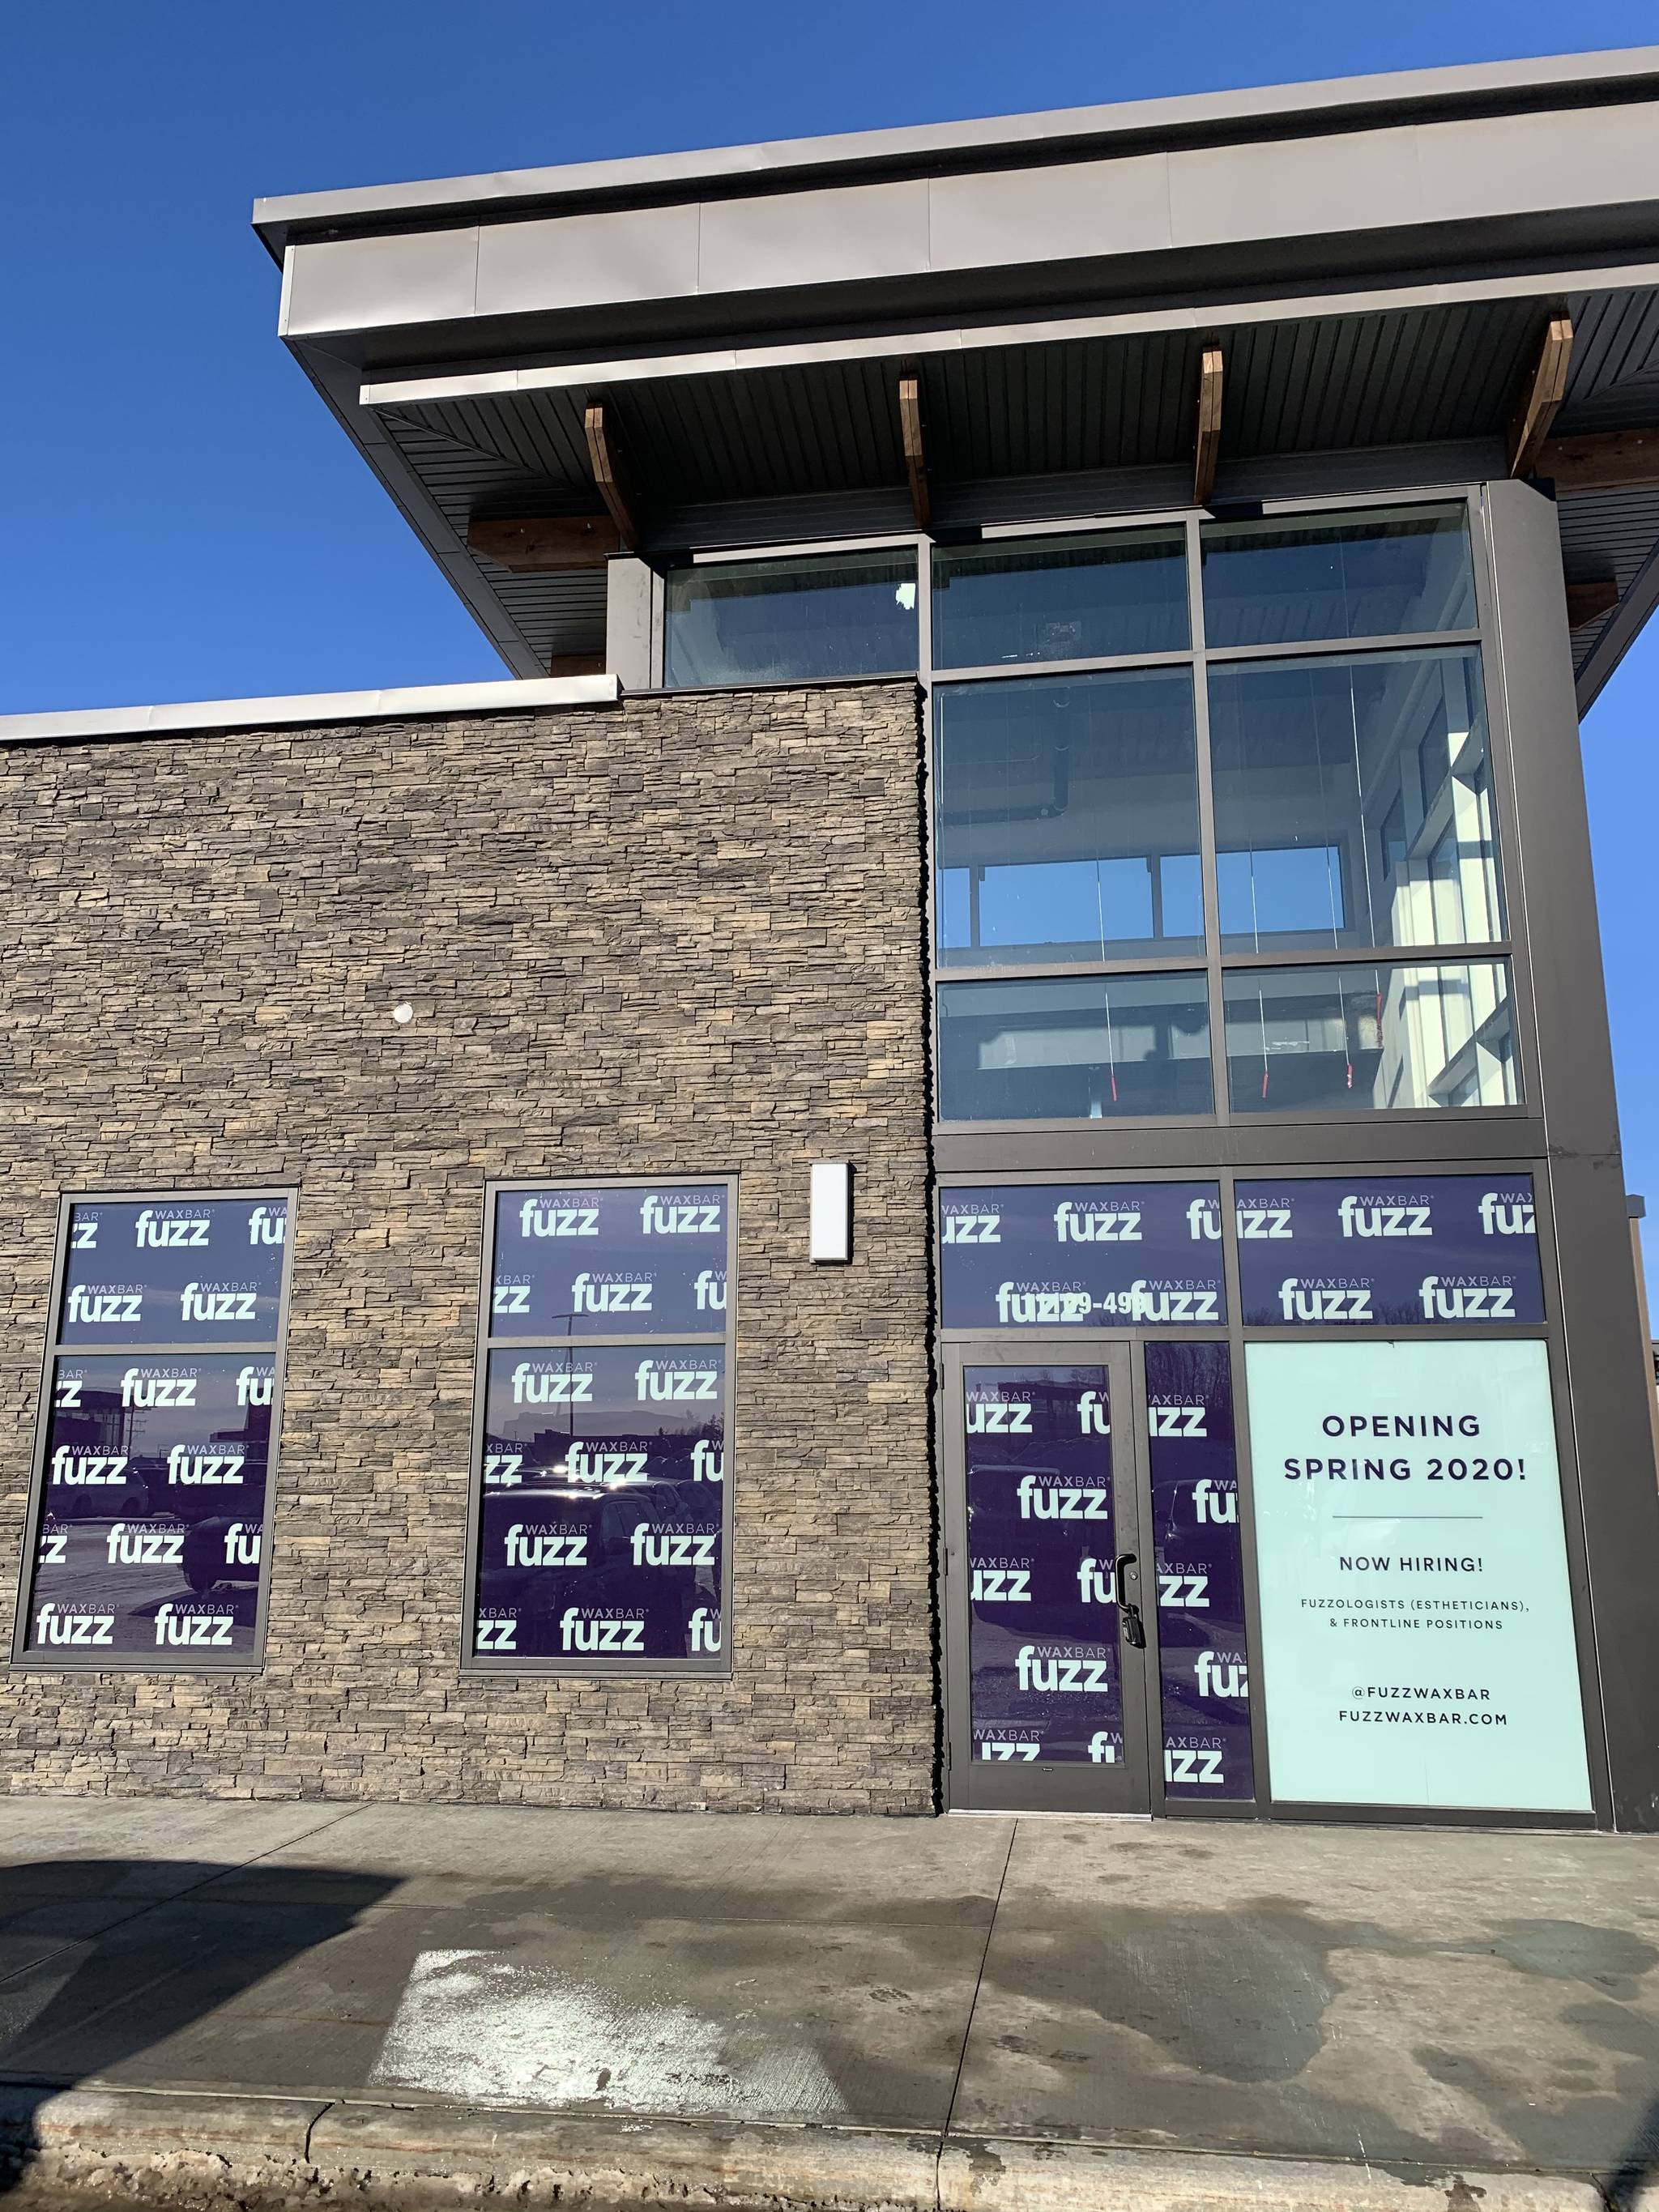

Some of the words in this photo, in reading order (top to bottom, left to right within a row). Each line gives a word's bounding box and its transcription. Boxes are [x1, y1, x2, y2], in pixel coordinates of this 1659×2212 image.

[540, 1198, 599, 1208] WAXBAR
[660, 1195, 720, 1204] WAXBAR
[1075, 1201, 1140, 1212] WAXBAR
[1360, 1195, 1429, 1206] WAXBAR
[155, 1209, 211, 1219] WAXBAR
[520, 1199, 599, 1238] fuzz
[640, 1196, 720, 1234] fuzz
[1054, 1202, 1142, 1242] fuzz
[1337, 1196, 1432, 1238] fuzz
[135, 1210, 210, 1247] fuzz
[249, 1207, 286, 1245] fu
[593, 1272, 652, 1282] WAXBAR
[1149, 1280, 1216, 1290] WAXBAR
[1300, 1278, 1369, 1289] WAXBAR
[1441, 1276, 1512, 1286] WAXBAR
[87, 1285, 143, 1294] WAXBAR
[201, 1282, 257, 1292] WAXBAR
[572, 1272, 652, 1313] fuzz
[1016, 1281, 1081, 1292] WAXBAR
[68, 1285, 143, 1323] fuzz
[181, 1282, 257, 1321] fuzz
[996, 1282, 1084, 1323] fuzz
[1131, 1280, 1219, 1321] fuzz
[1278, 1278, 1373, 1320] fuzz
[1419, 1276, 1516, 1319] fuzz
[532, 1362, 592, 1372] WAXBAR
[655, 1359, 717, 1370] WAXBAR
[141, 1368, 197, 1378] WAXBAR
[635, 1360, 717, 1400] fuzz
[121, 1368, 196, 1407] fuzz
[236, 1366, 275, 1406] fu
[512, 1363, 592, 1403] fuzz
[1149, 1395, 1204, 1405] AXBAR
[1322, 1414, 1480, 1438] OPENING
[72, 1446, 128, 1455] WAXBAR
[187, 1445, 245, 1455] WAXBAR
[586, 1442, 647, 1451] WAXBAR
[52, 1446, 128, 1485] fuzz
[167, 1444, 245, 1485] fuzz
[565, 1441, 648, 1483] fuzz
[1284, 1458, 1411, 1481] SPRING
[1427, 1458, 1526, 1481] 2020!
[1039, 1476, 1106, 1487] WAXBAR
[1017, 1475, 1108, 1519] fuzz
[1192, 1479, 1239, 1524] fu
[127, 1524, 185, 1533] WAXBAR
[526, 1524, 587, 1535] WAXBAR
[652, 1523, 714, 1534] WAXBAR
[107, 1523, 184, 1564] fuzz
[505, 1524, 587, 1566] fuzz
[631, 1523, 715, 1566] fuzz
[1339, 1556, 1391, 1571] NOW
[1399, 1557, 1483, 1572] HIRING!
[57, 1604, 115, 1613] WAXBAR
[175, 1605, 234, 1614] WAXBAR
[582, 1608, 644, 1618] WAXBAR
[1301, 1598, 1405, 1609] FUZZOLOGISTS
[1410, 1599, 1529, 1613] (ESTHETICIANS),
[36, 1603, 114, 1644] fuzz
[155, 1603, 233, 1645] fuzz
[561, 1608, 644, 1651] fuzz
[1329, 1617, 1337, 1627] &
[1343, 1618, 1420, 1629] FRONTLINE
[1427, 1619, 1503, 1630] POSITIONS
[1038, 1647, 1106, 1657] WAXBAR
[1015, 1646, 1108, 1692] fuzz
[1351, 1686, 1491, 1701] @FUZZWAXBAR
[1339, 1710, 1508, 1726] FUZZWAXBAR.COM
